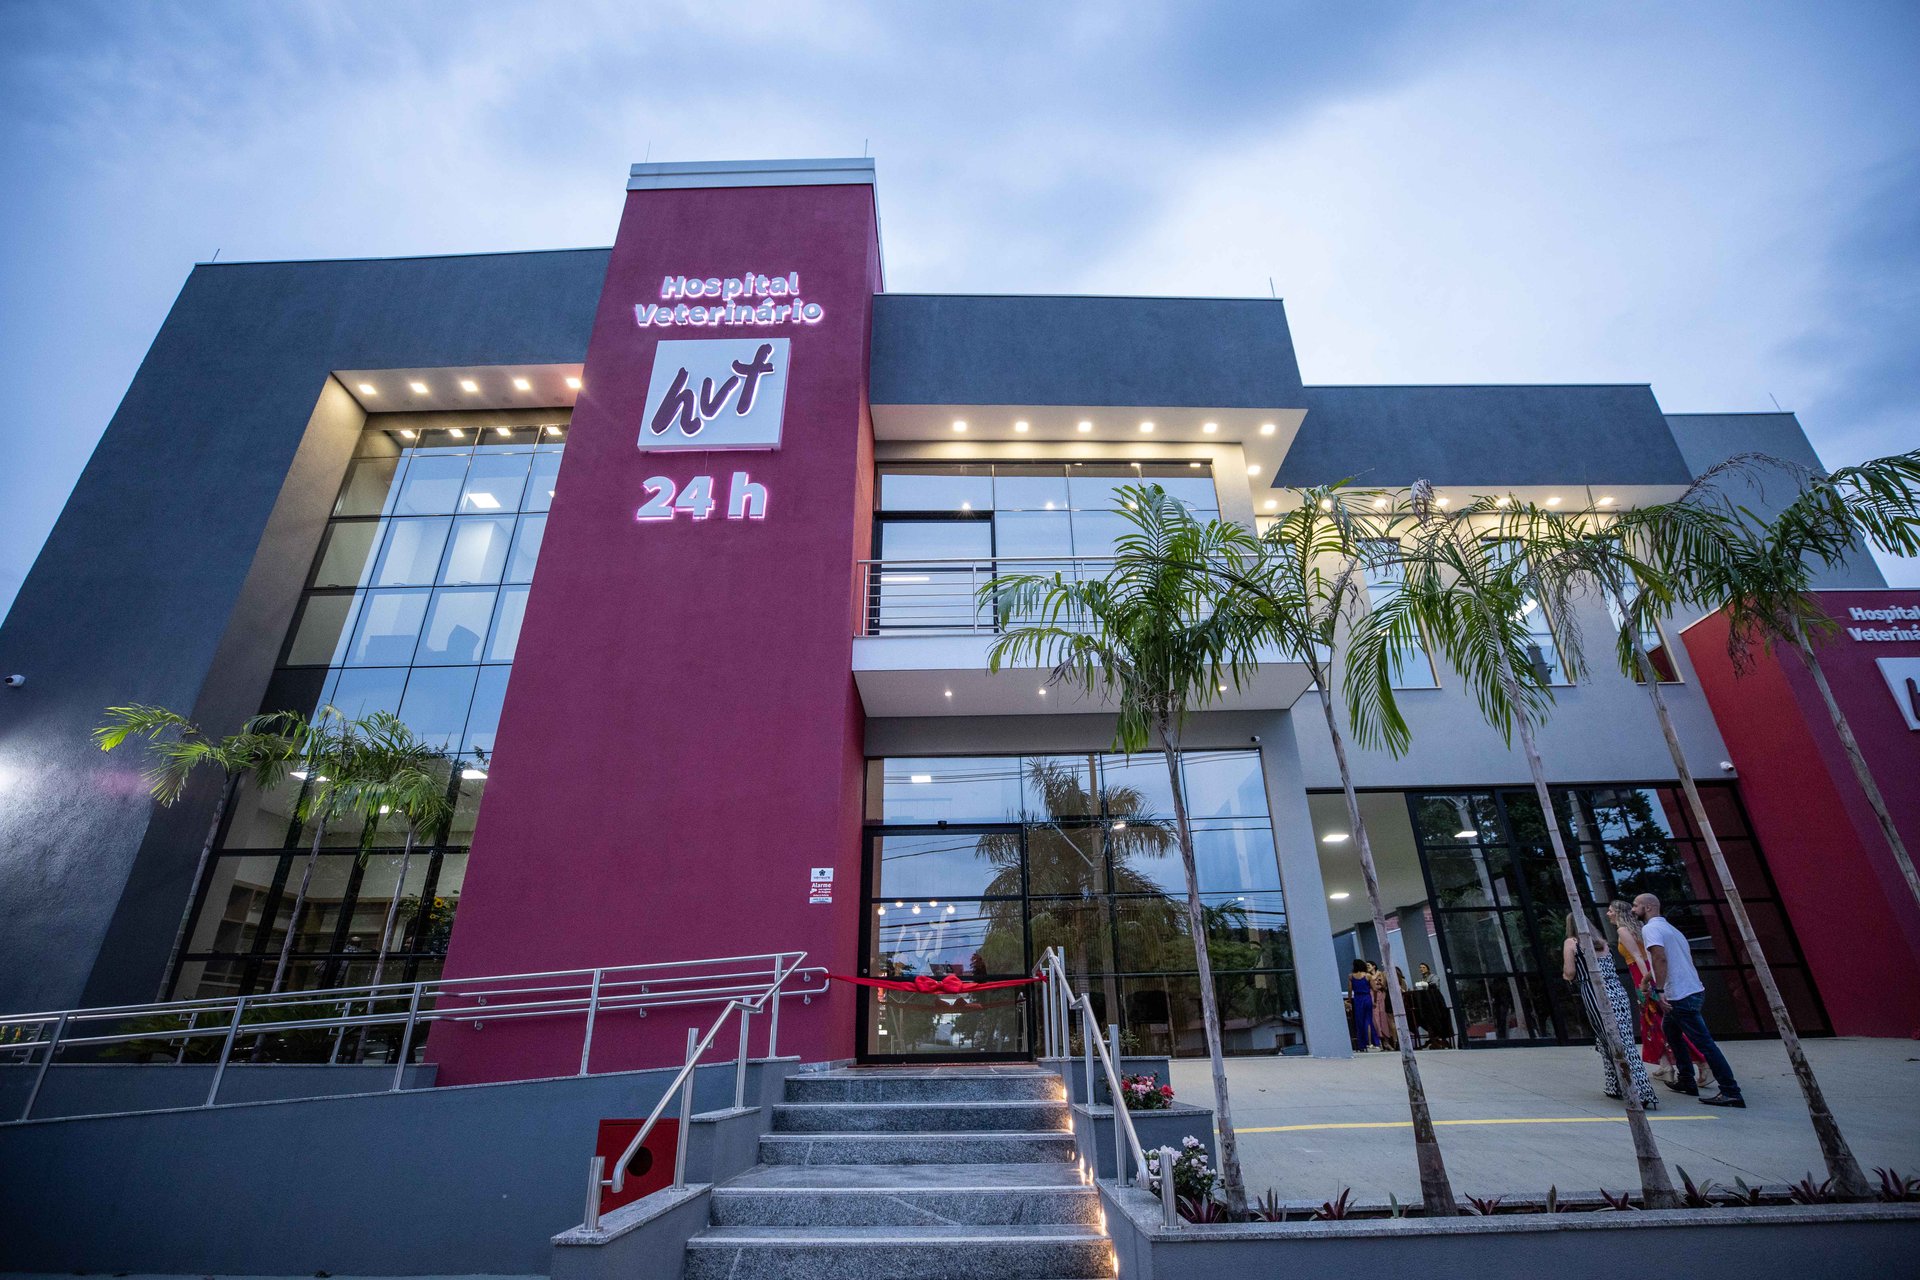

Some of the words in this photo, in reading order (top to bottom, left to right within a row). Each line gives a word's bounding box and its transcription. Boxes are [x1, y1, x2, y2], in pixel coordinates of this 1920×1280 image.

[661, 272, 800, 299] Hospital
[635, 298, 823, 327] Veterinário
[651, 343, 774, 437] hvt
[637, 475, 714, 520] 24
[727, 472, 768, 520] h
